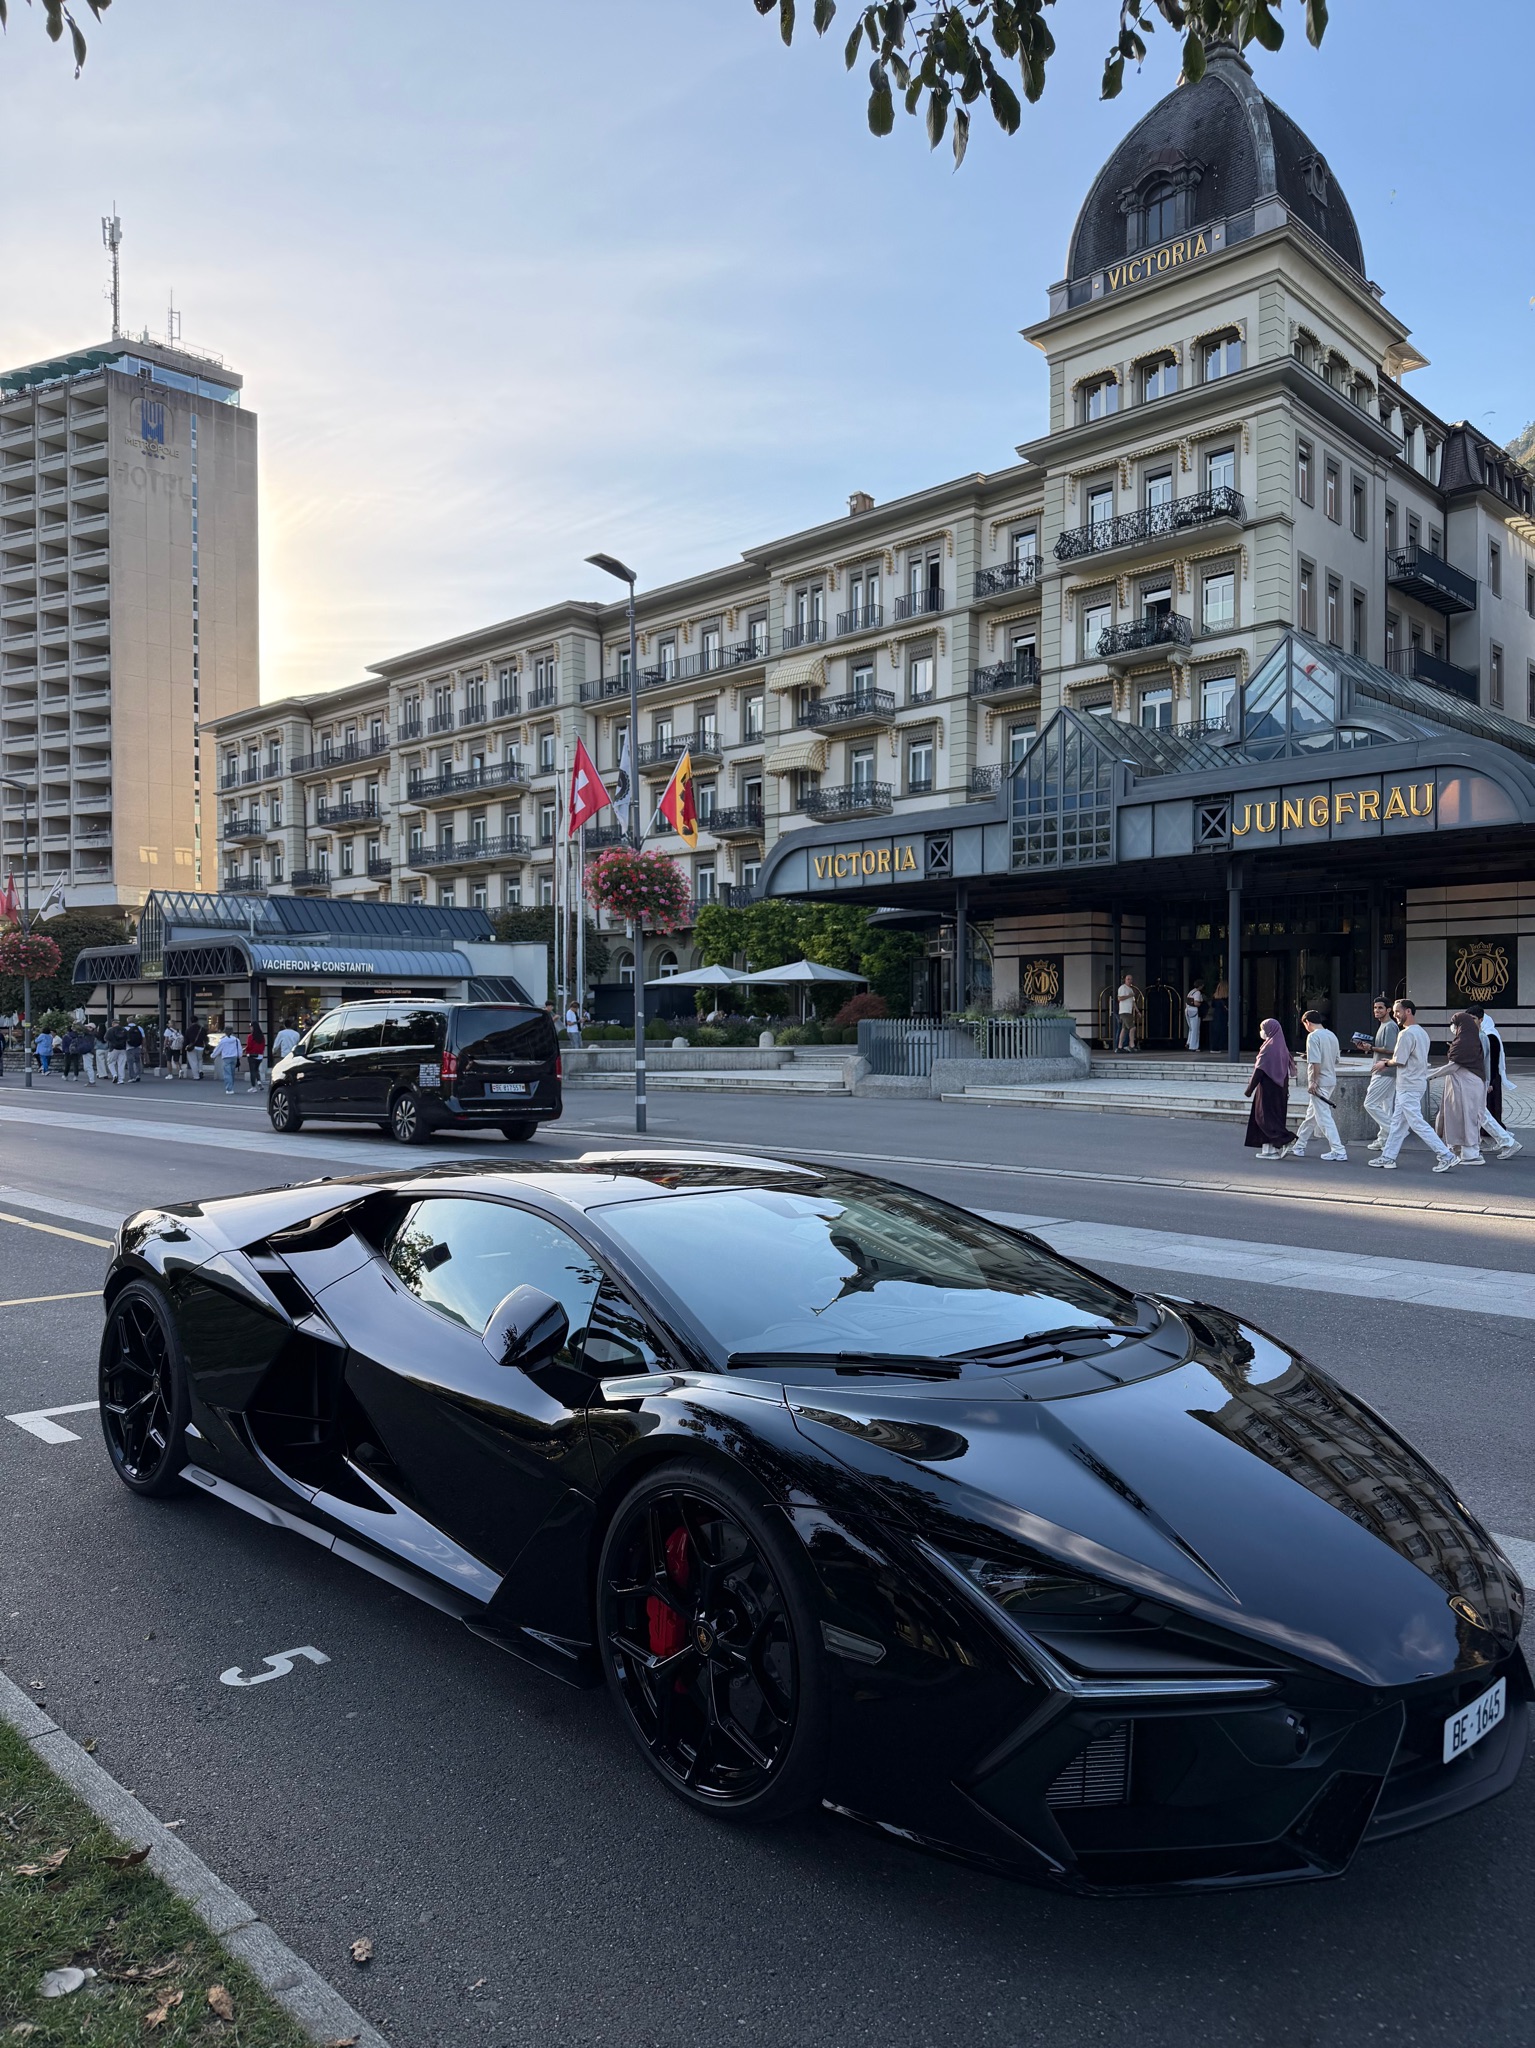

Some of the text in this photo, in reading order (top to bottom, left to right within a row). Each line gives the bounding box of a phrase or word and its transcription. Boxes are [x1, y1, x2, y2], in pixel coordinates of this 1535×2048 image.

[1108, 233, 1208, 291] VICTORIA
[124, 437, 179, 458] METROPOLE
[1232, 782, 1435, 836] JUNGFRAU
[813, 845, 917, 879] VICTORIA
[262, 959, 374, 972] VACHERON CONSTANTIN
[219, 1645, 332, 1686] 5
